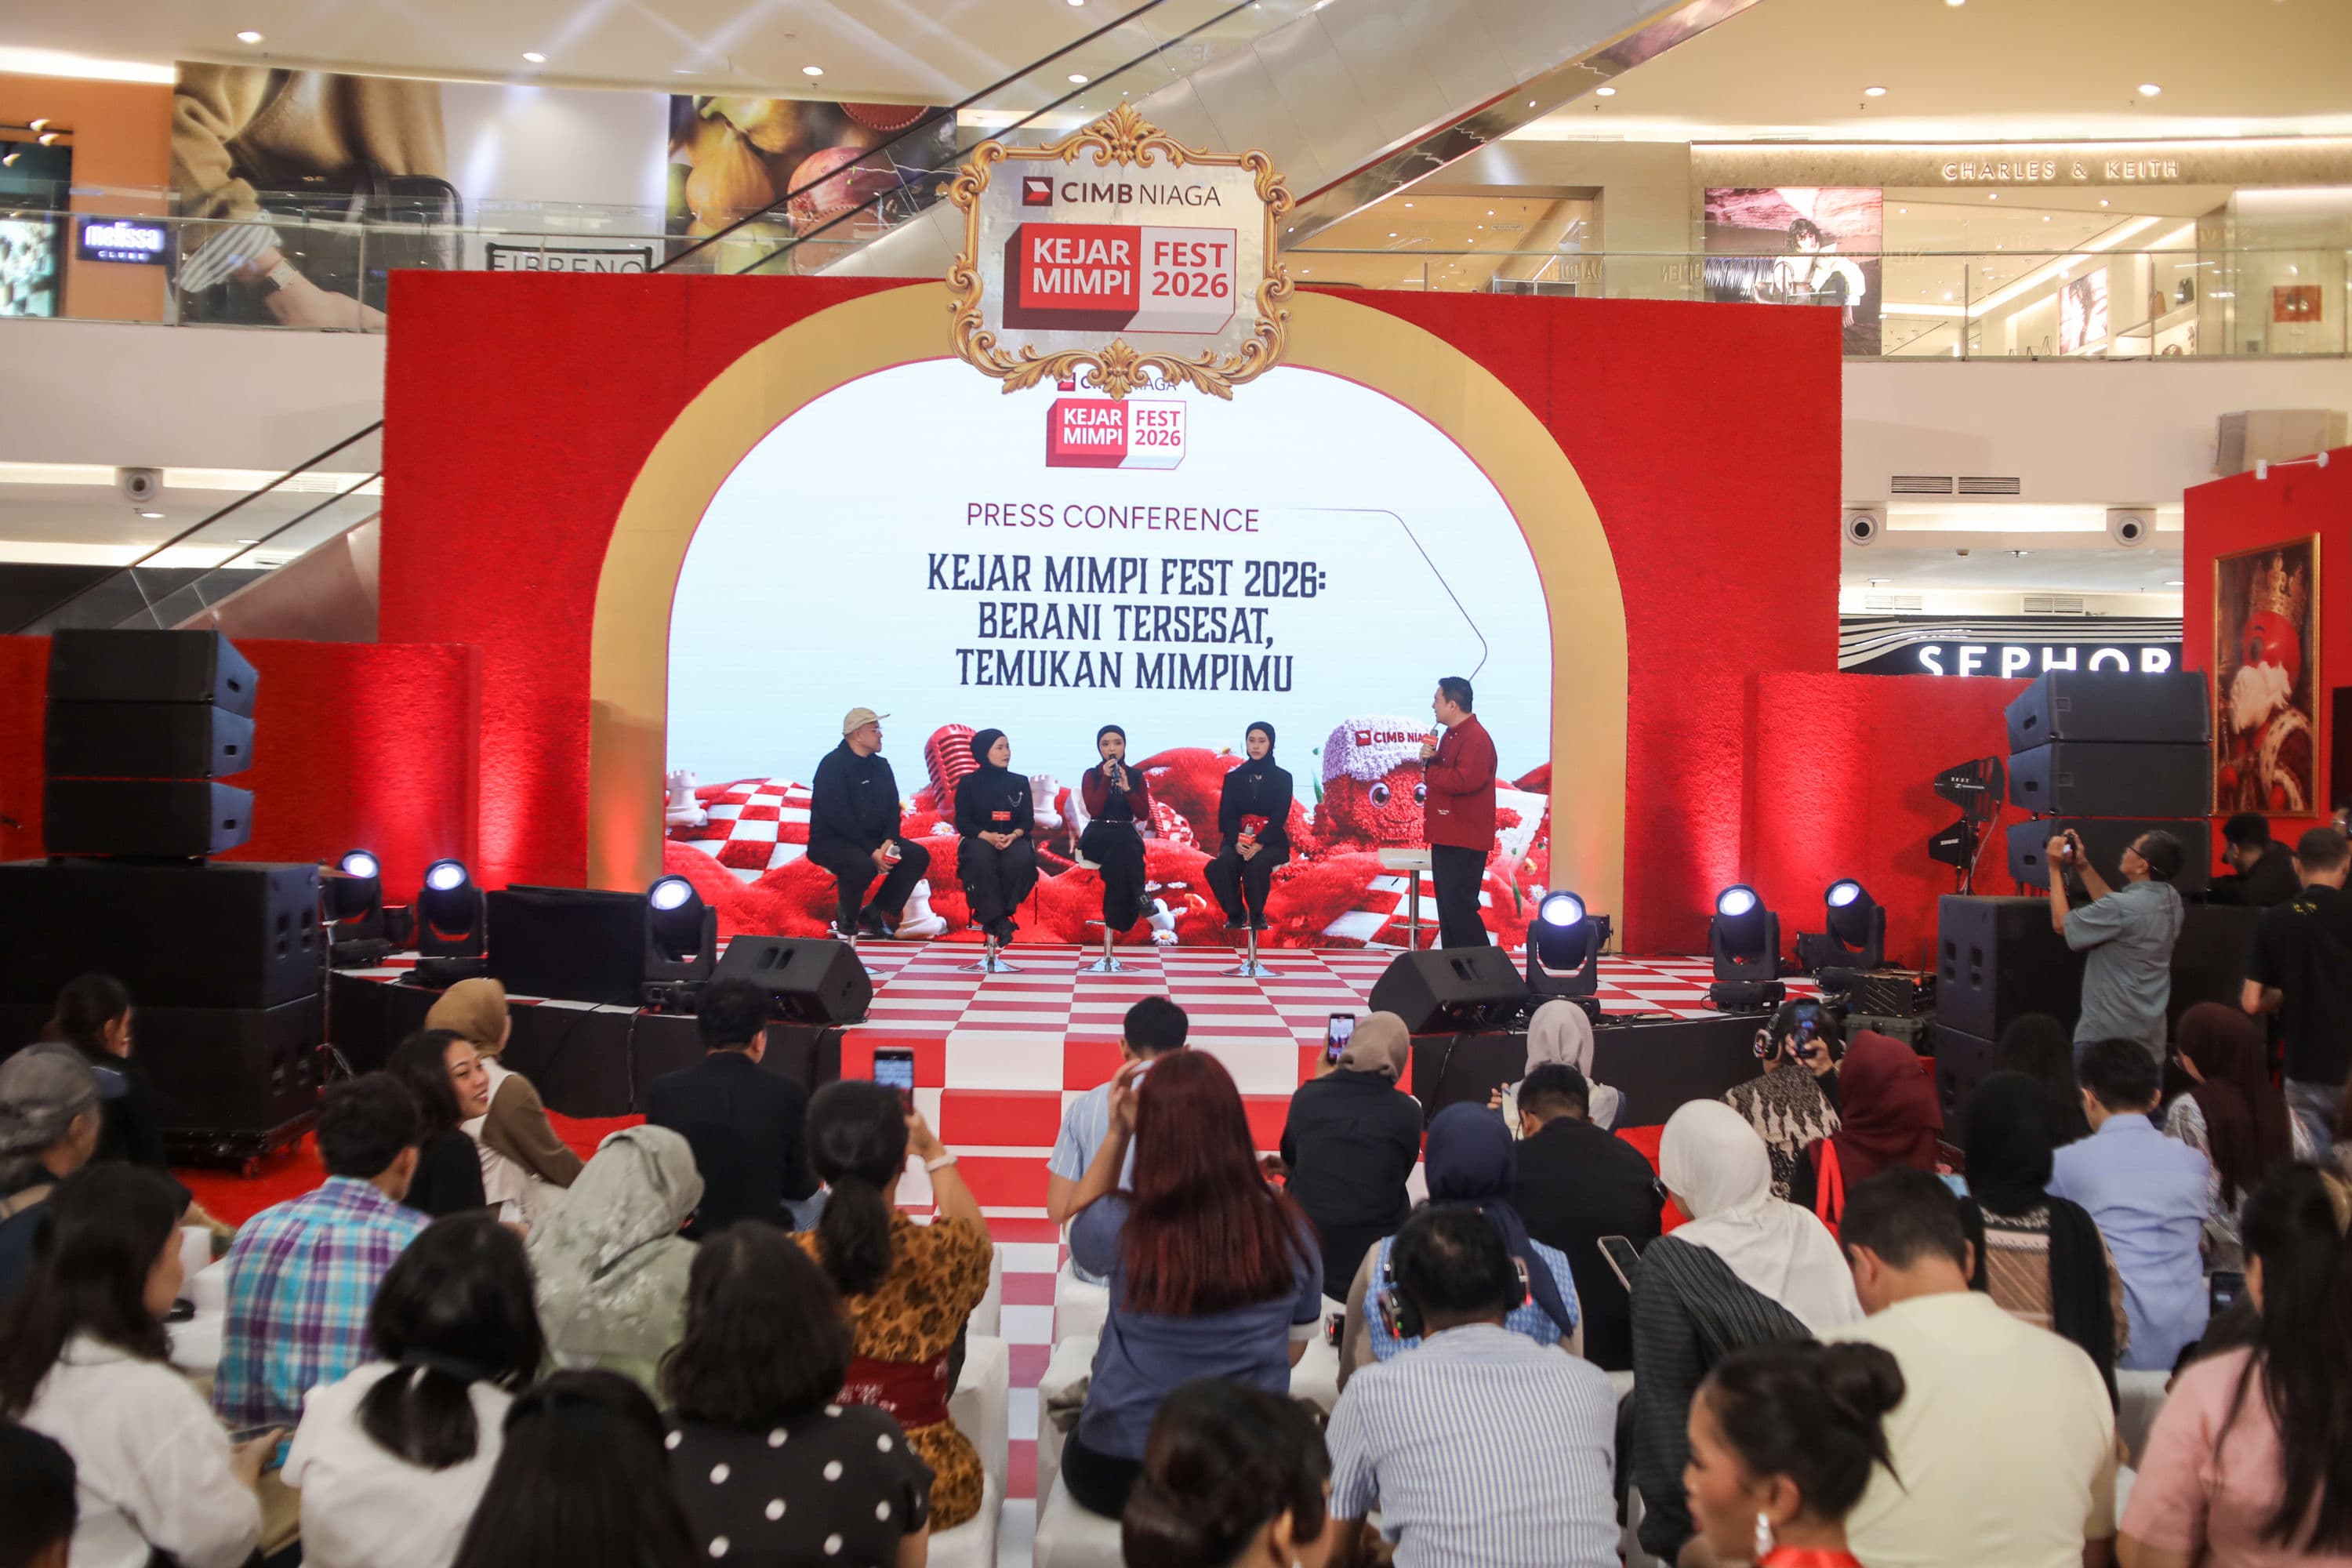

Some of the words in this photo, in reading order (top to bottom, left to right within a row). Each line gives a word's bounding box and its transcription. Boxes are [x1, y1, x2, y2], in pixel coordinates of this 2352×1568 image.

[1944, 162, 2055, 179] CHARLES
[2072, 162, 2088, 178] &
[2107, 161, 2179, 178] KEITH
[1061, 182, 1133, 204] CIMB
[1139, 184, 1221, 206] NIAGA
[85, 222, 162, 250] melissa
[1033, 238, 1131, 265] KEJAR
[1154, 241, 1229, 268] FEST
[1033, 267, 1131, 296] MIMPI
[1152, 271, 1229, 298] 2026
[1064, 408, 1123, 426] KEJAR
[1136, 410, 1181, 427] FEST
[1063, 427, 1123, 445] MIMPI
[1134, 429, 1181, 446] 2026
[967, 503, 1054, 527] PRESS
[1063, 504, 1259, 532] CONFERENCE
[927, 553, 1032, 592] KEJAR
[1044, 555, 1149, 595] MIMPI
[1160, 557, 1233, 597] FEST
[1244, 560, 1327, 598] 2026:
[978, 602, 1102, 641] BERANI
[1113, 604, 1274, 649] TERSESAT,
[956, 648, 1123, 689] TEMUKAN
[1135, 652, 1294, 692] MIMPIMU
[1374, 731, 1405, 743] CIMB
